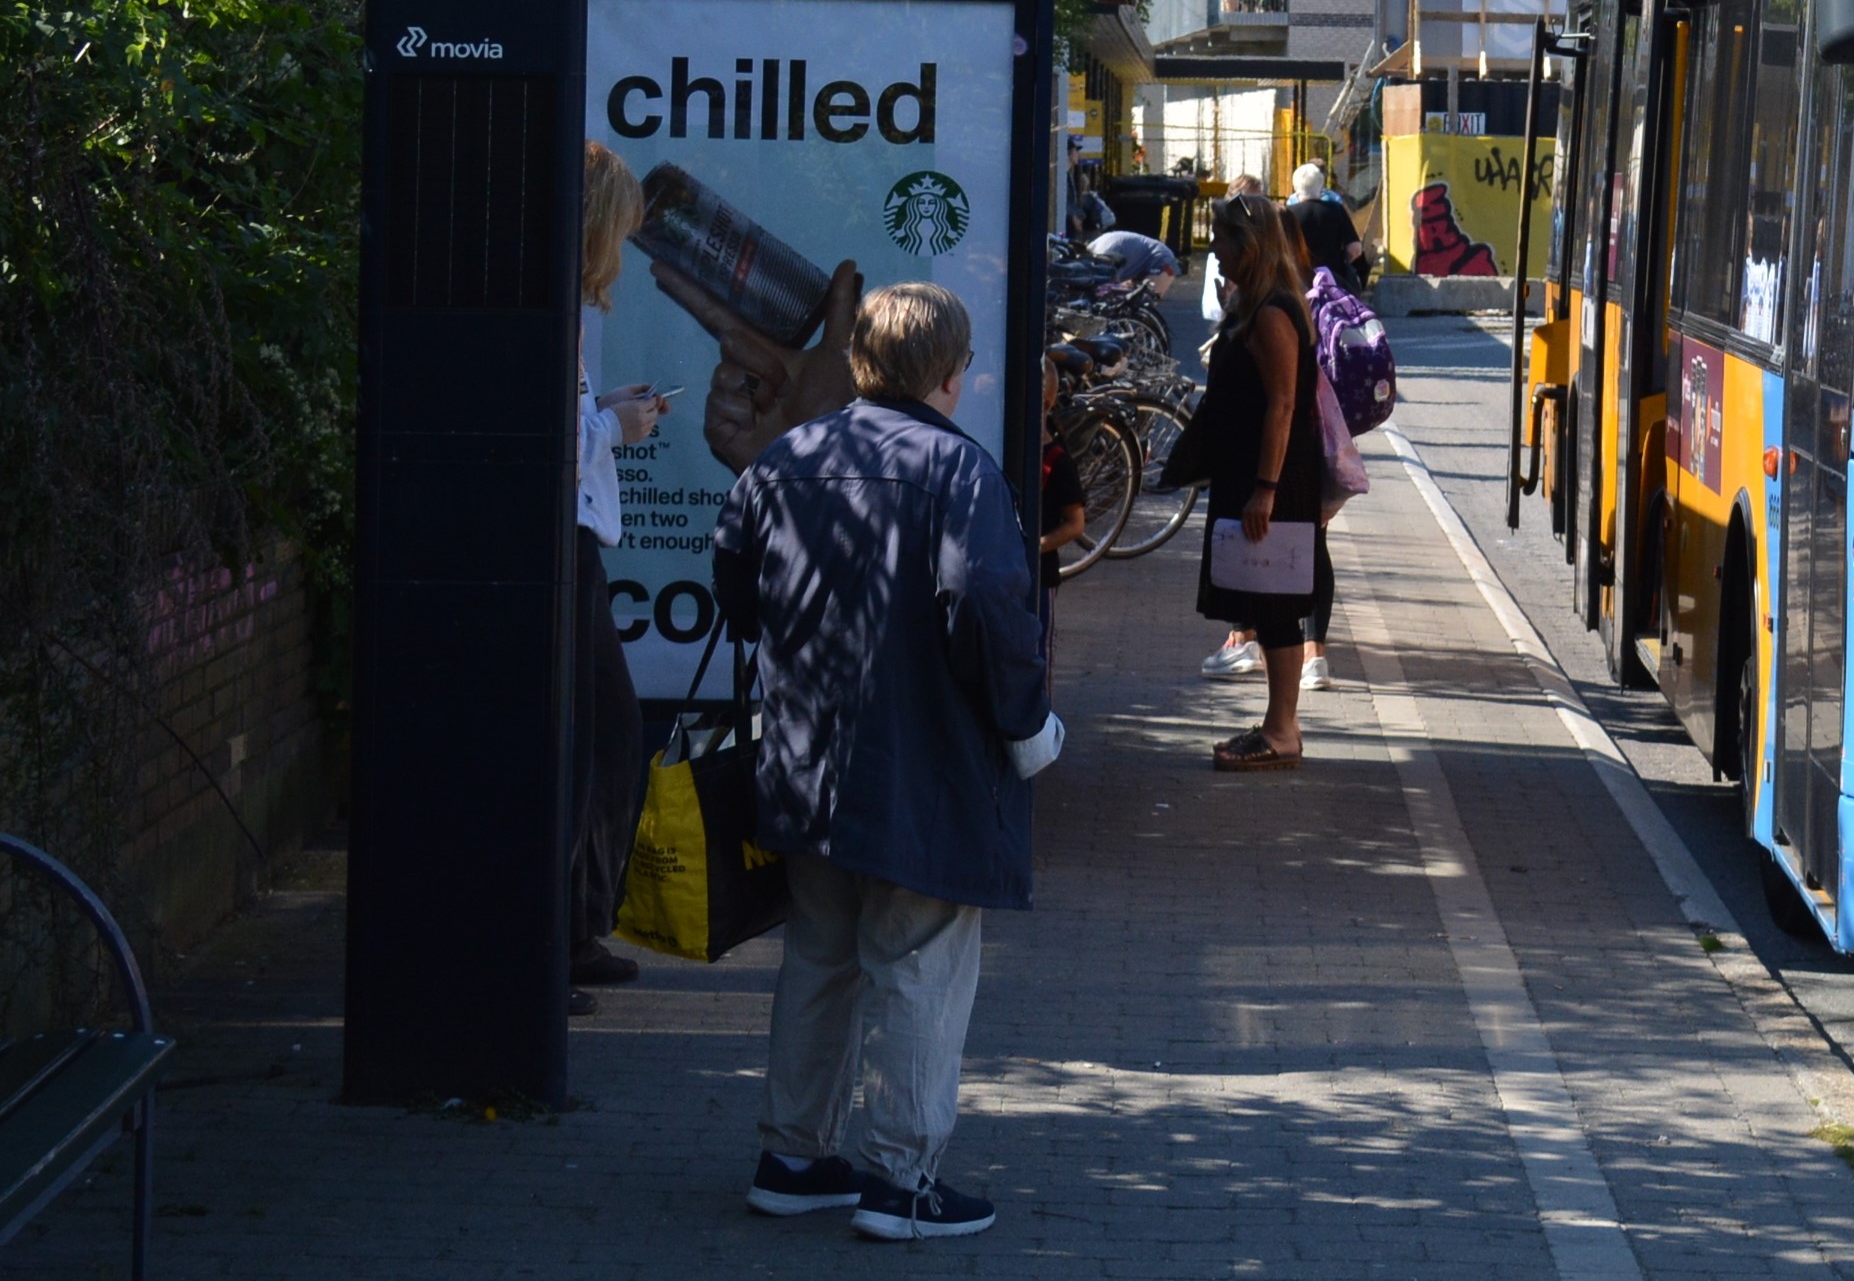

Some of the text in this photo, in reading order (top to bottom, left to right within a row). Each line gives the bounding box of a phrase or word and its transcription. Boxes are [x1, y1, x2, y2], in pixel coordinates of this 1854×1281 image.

[431, 37, 503, 58] movia
[606, 57, 938, 145] chilled
[651, 513, 689, 528] two
